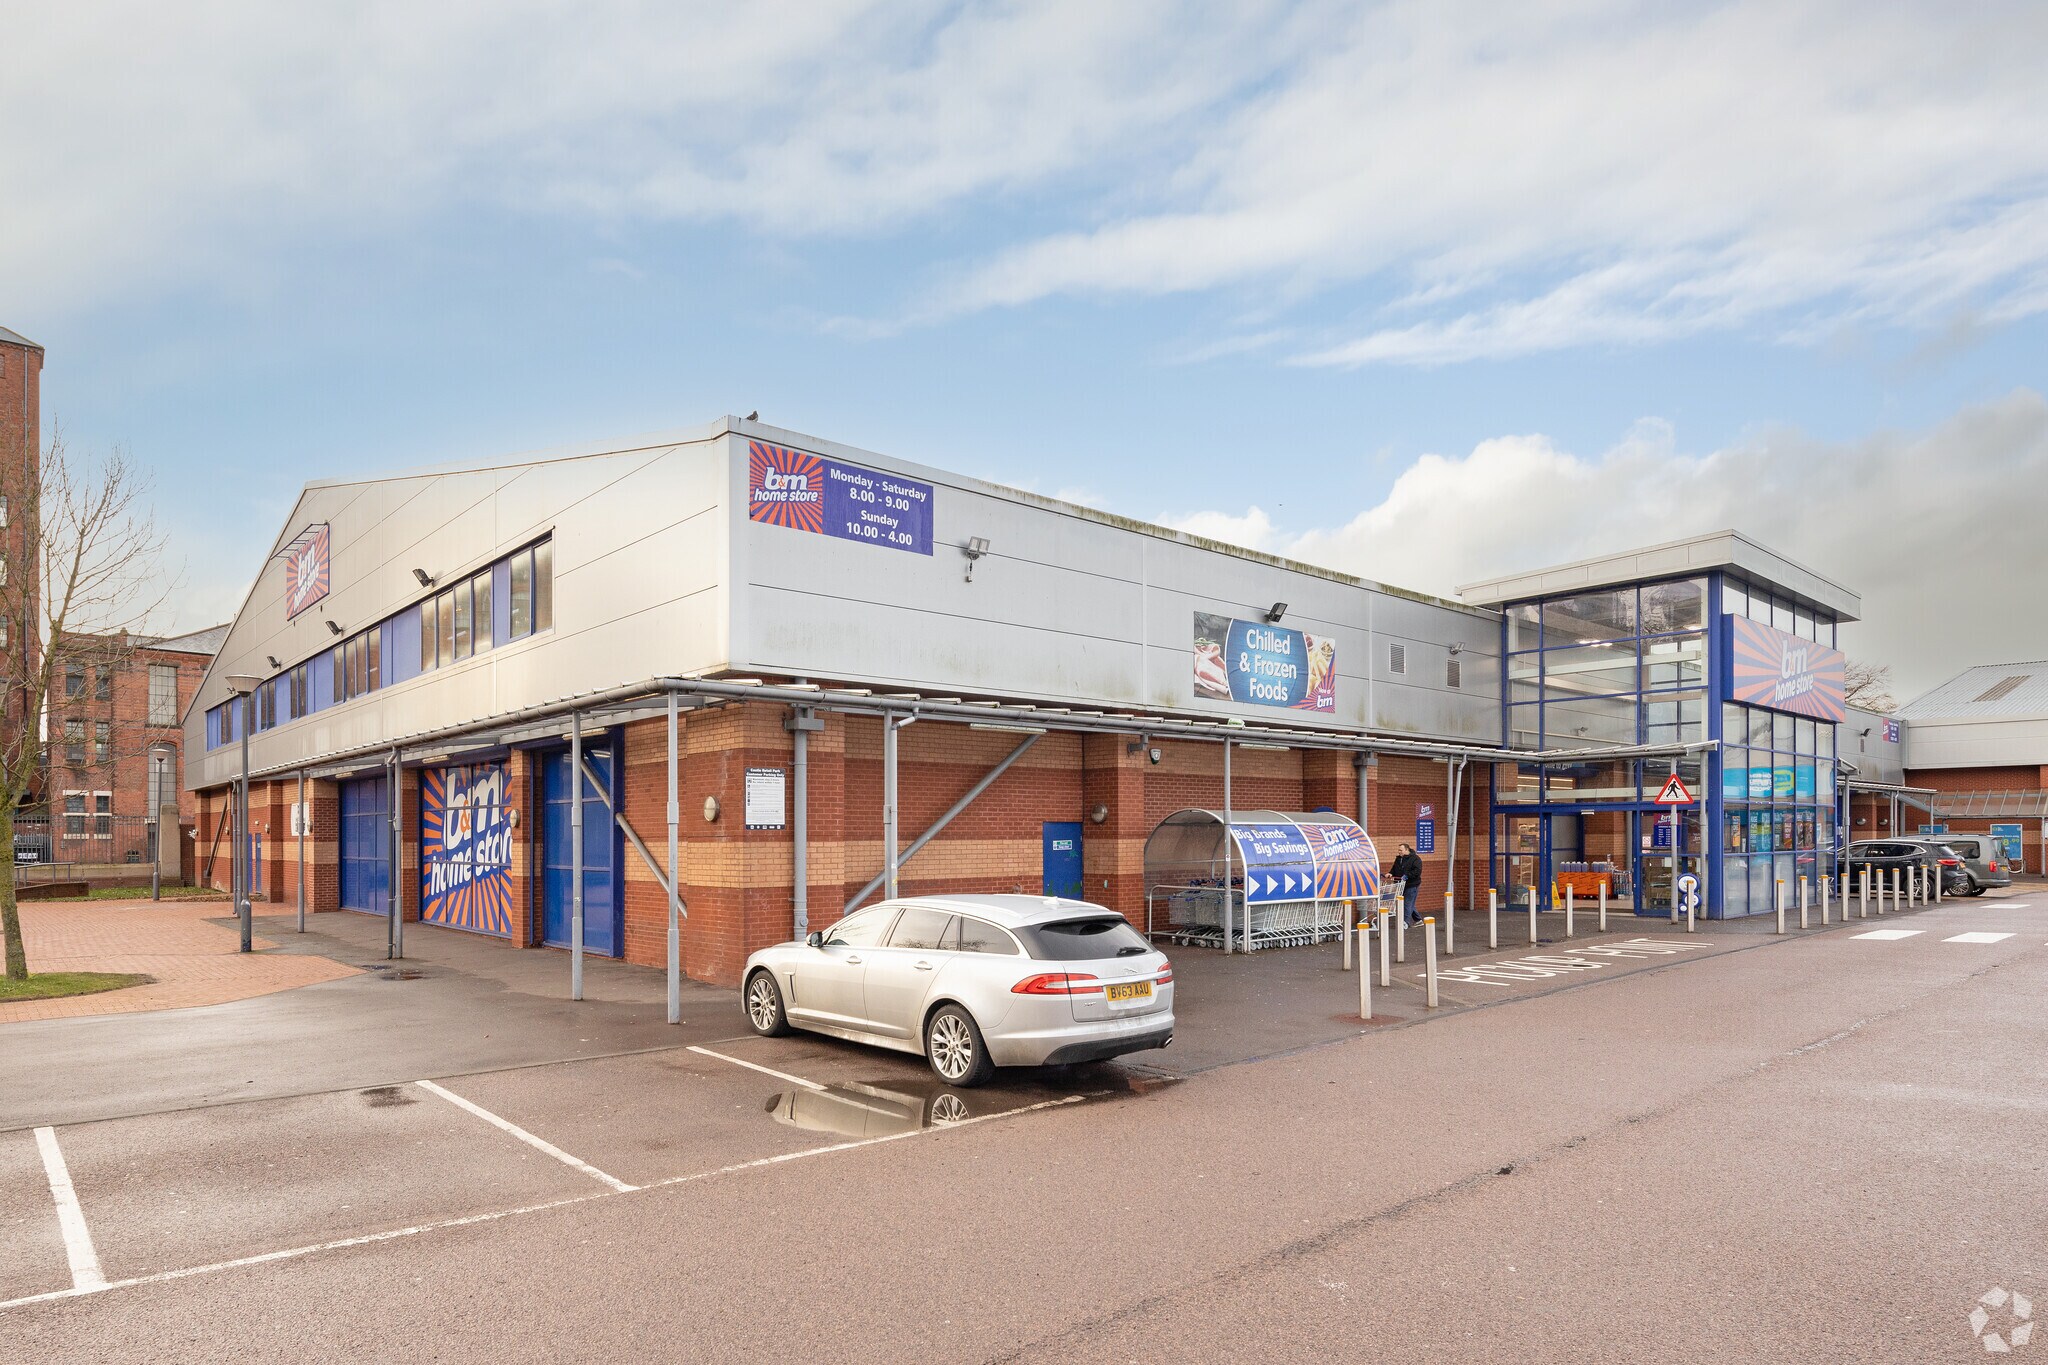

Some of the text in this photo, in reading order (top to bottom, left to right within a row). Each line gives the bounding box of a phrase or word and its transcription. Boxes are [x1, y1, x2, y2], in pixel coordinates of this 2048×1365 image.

[754, 488, 818, 502] home store
[830, 468, 874, 489] Monday
[882, 480, 926, 502] Saturday
[849, 487, 875, 504] 8.00
[885, 495, 909, 511] 9.00
[860, 509, 898, 529] Sunday
[846, 522, 878, 539] 10.00
[888, 530, 912, 546] 4.00
[1246, 629, 1290, 655] Chilled
[1239, 652, 1297, 679] & Frozen
[1249, 678, 1288, 702] Foods
[1774, 673, 1814, 702] home store
[1234, 828, 1287, 841] Big Brands
[1253, 842, 1309, 857] Big Savings
[1323, 838, 1360, 858] home store
[431, 826, 512, 896] home stor
[1110, 983, 1149, 999] BV63 AAU
